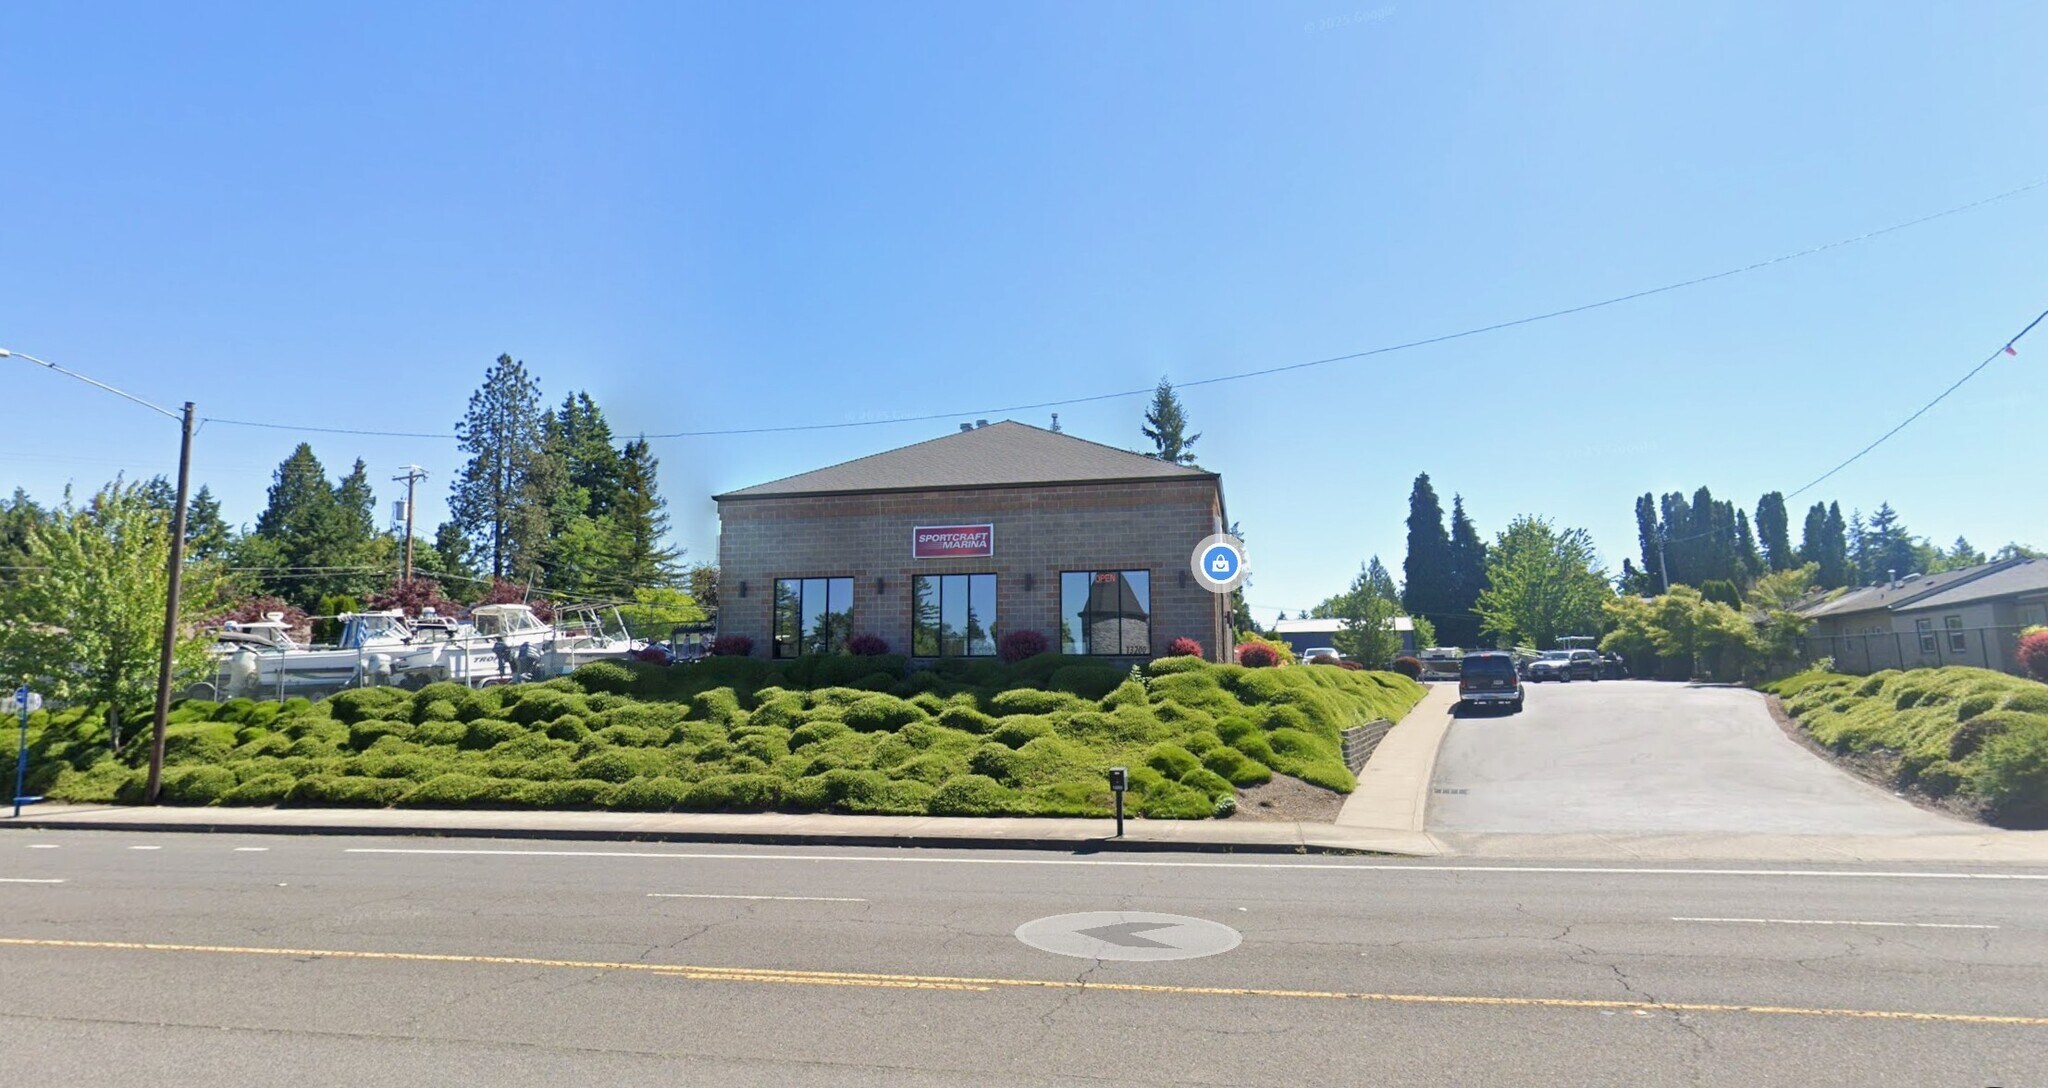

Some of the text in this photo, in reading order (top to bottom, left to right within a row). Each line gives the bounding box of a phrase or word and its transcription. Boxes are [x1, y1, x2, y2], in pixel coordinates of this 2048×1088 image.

[918, 532, 988, 543] SPORTCRAFT
[942, 540, 987, 549] MARINA
[1096, 573, 1116, 583] OPEN
